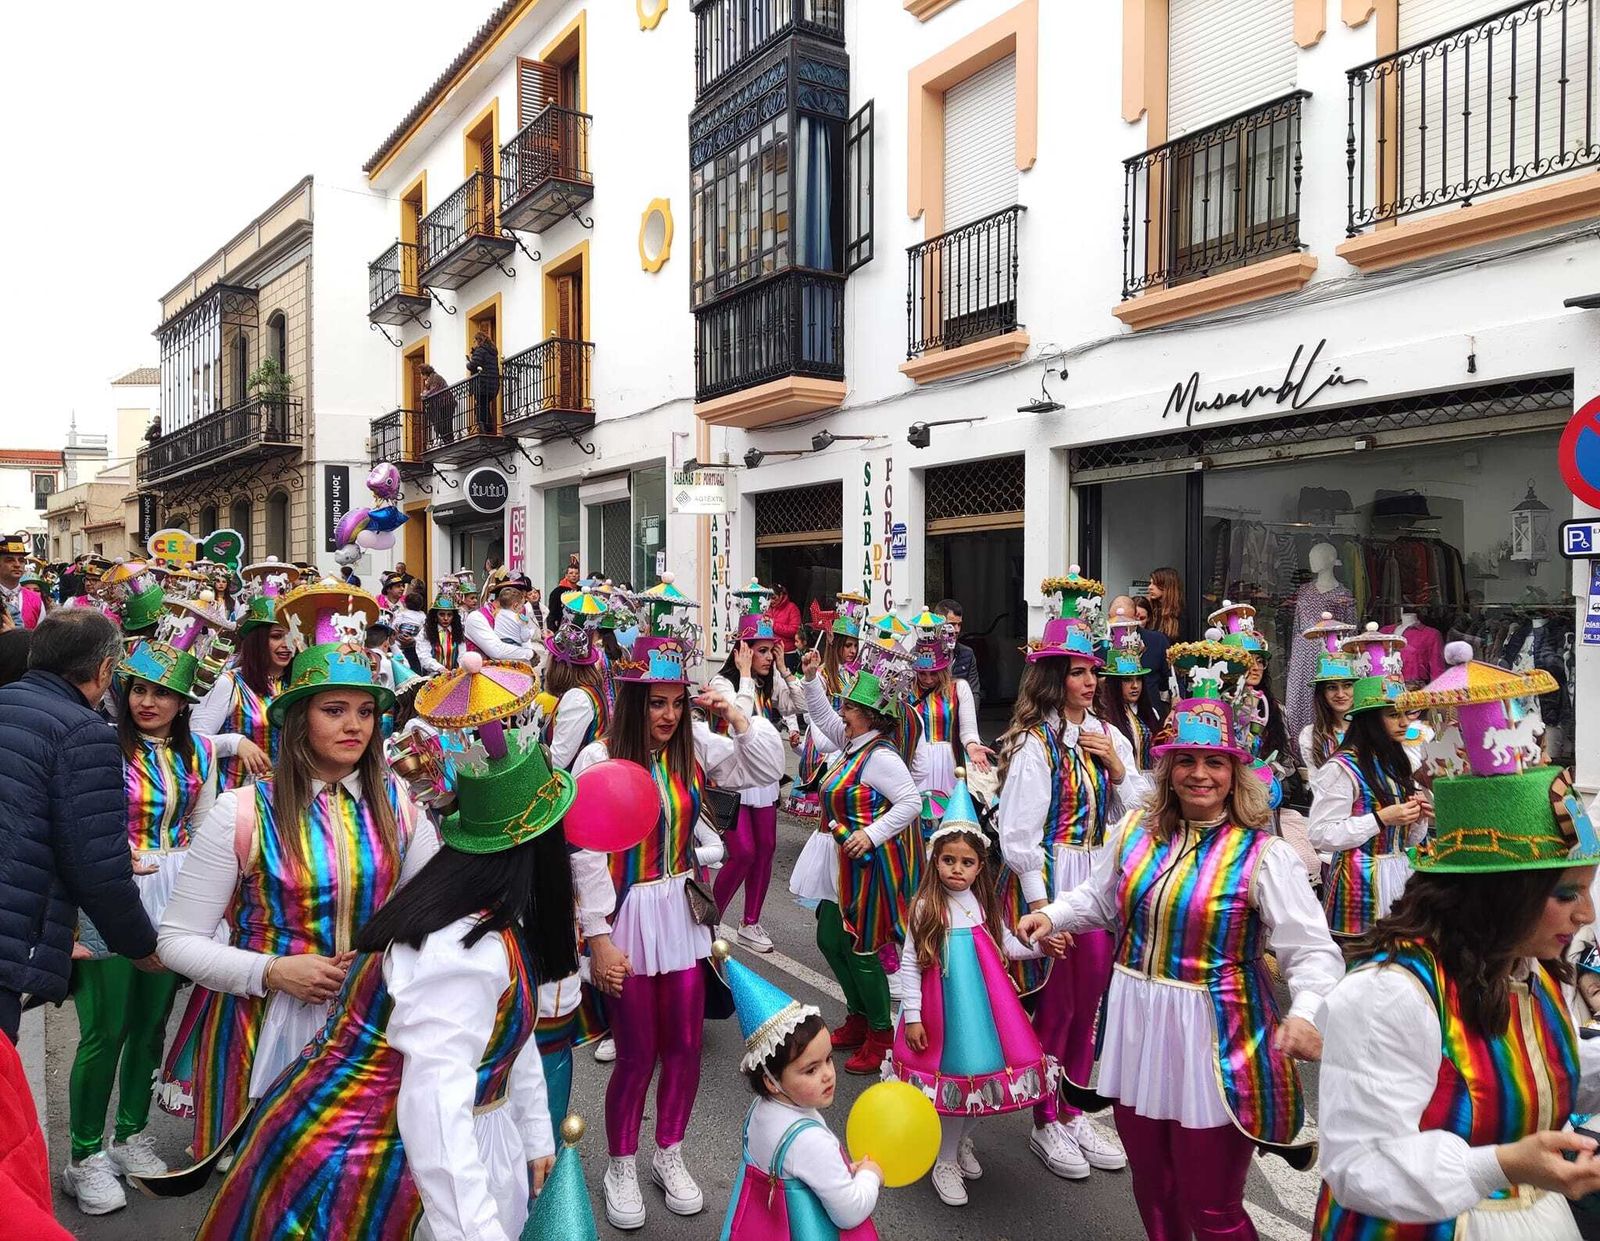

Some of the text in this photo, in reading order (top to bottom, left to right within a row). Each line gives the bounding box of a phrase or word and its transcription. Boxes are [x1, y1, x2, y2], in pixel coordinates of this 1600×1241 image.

[332, 475, 341, 536] John Hollan
[862, 461, 872, 633] SABANA
[883, 457, 893, 613] PORTUG
[892, 533, 907, 546] ADT
[718, 555, 724, 585] DE
[873, 543, 883, 581] DE
